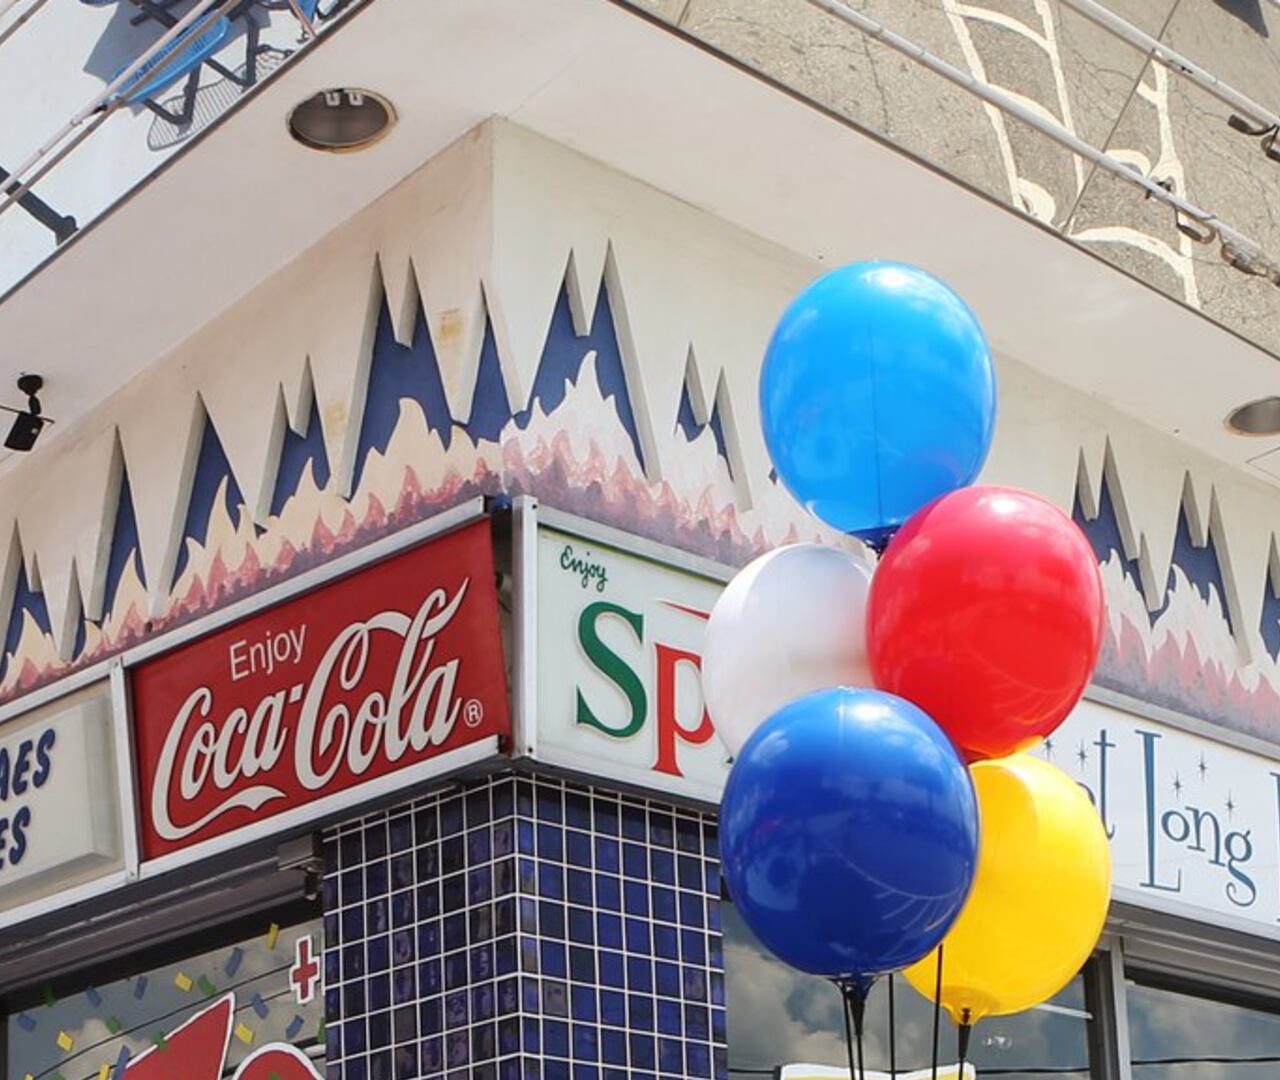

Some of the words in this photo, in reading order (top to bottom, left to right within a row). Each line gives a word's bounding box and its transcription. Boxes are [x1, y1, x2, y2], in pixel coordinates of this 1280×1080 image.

[559, 544, 609, 591] Enjoy
[151, 576, 471, 842] Coca-Cola
[229, 623, 308, 682] Enjoy
[1135, 729, 1257, 907] Long
